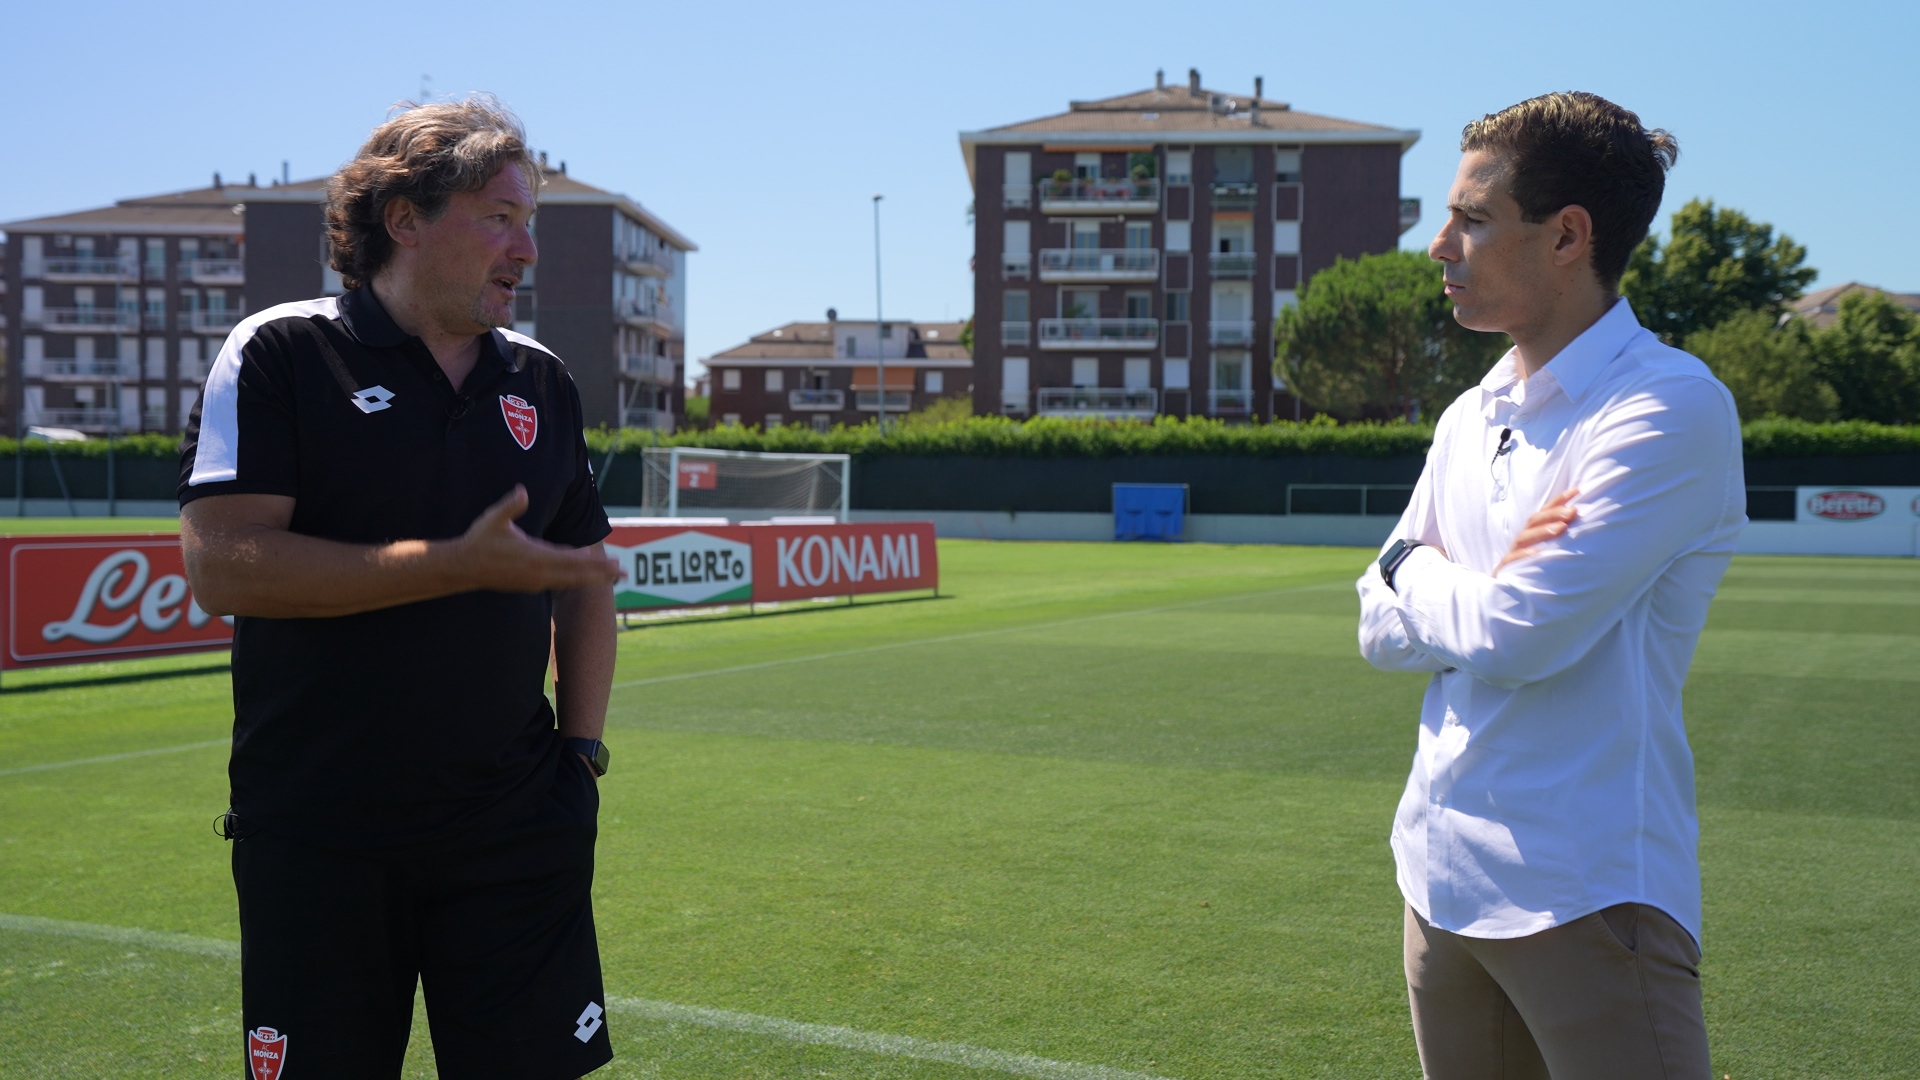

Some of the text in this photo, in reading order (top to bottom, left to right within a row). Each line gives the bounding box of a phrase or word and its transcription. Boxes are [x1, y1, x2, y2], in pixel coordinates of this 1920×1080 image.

[508, 411, 533, 423] MONZA
[689, 473, 699, 488] 2
[1811, 496, 1881, 514] Beretta
[635, 549, 744, 587] DELLORTO
[776, 533, 920, 588] KONAMI
[254, 1050, 278, 1060] MONZA
[262, 1044, 270, 1052] AC
